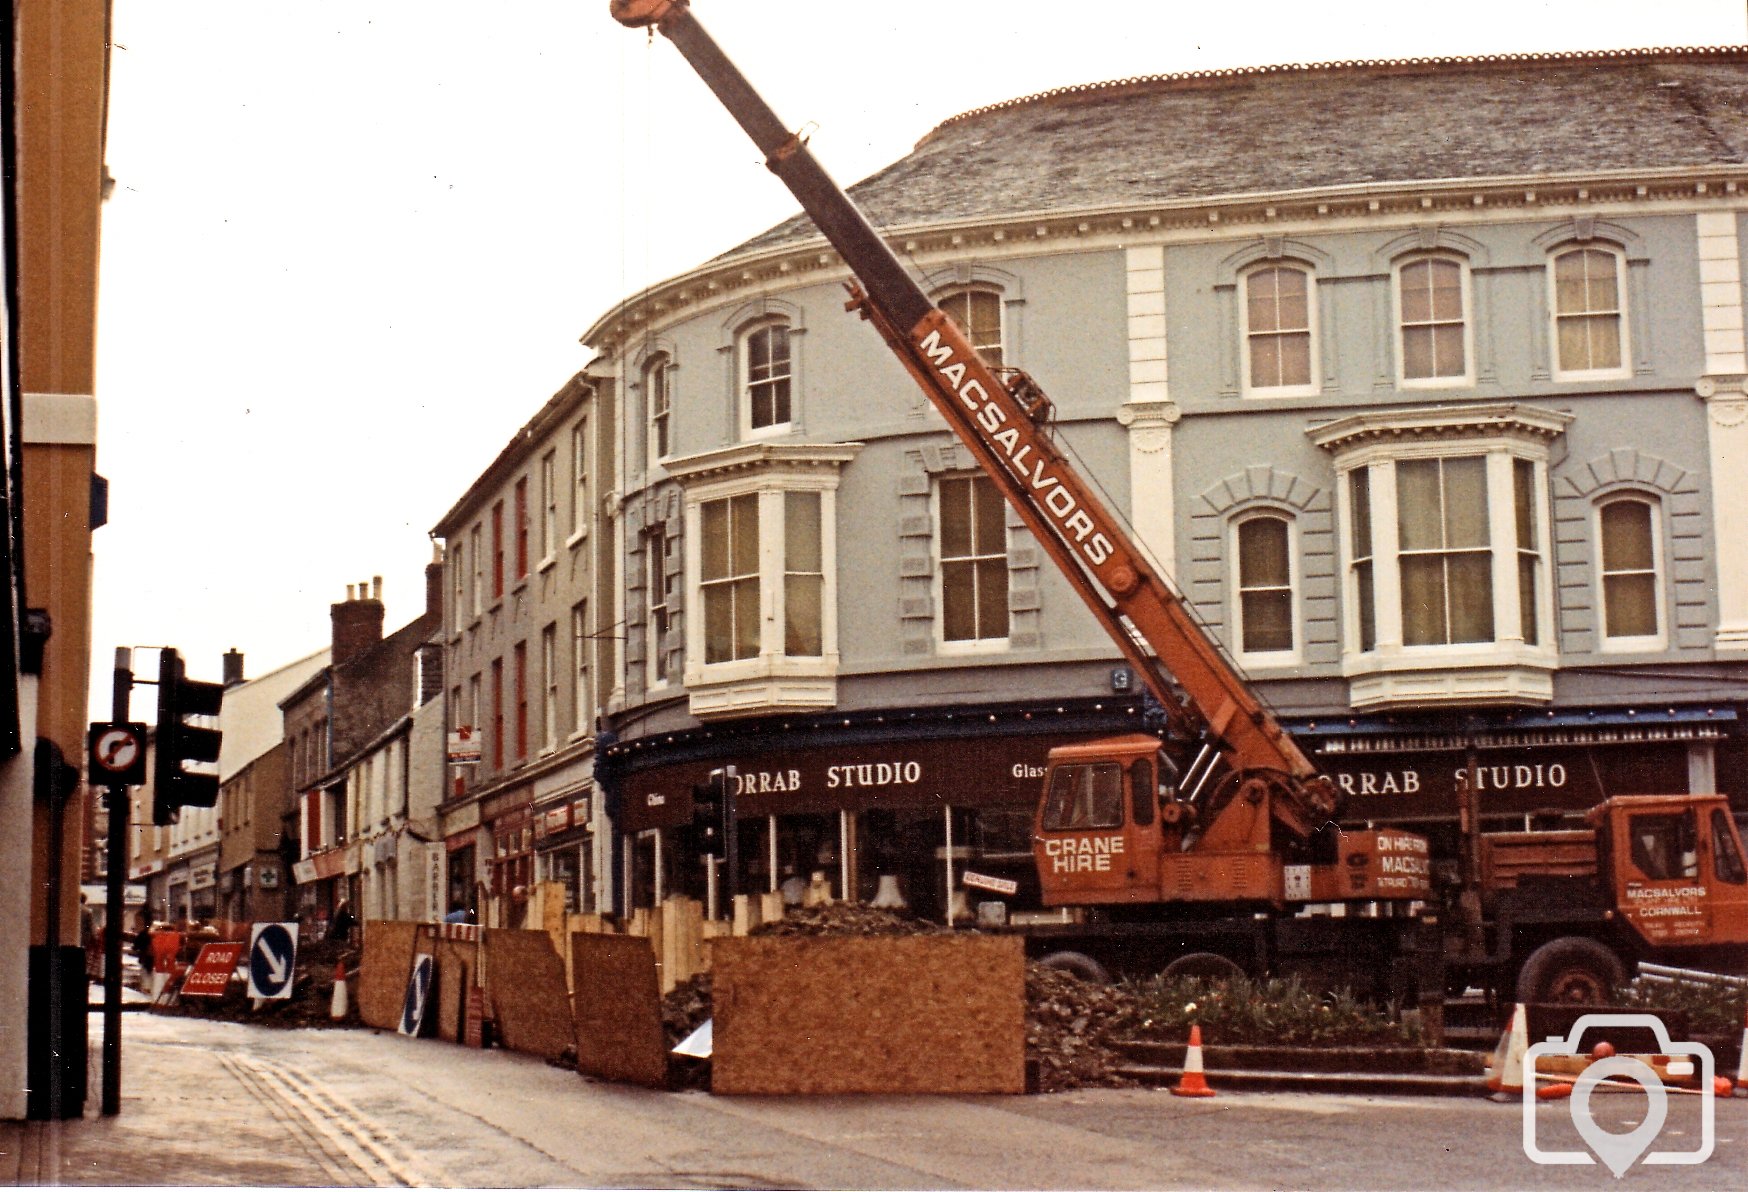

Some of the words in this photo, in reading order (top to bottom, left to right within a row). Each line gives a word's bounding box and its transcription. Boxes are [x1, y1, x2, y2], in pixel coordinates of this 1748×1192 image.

[920, 330, 1114, 565] MACSALVORS
[827, 761, 921, 788] STUDIO
[1045, 836, 1124, 856] CRANE
[1377, 836, 1392, 850] ON
[1053, 853, 1111, 873] HIRE
[1627, 886, 1706, 898] MACSALVORS
[1640, 905, 1702, 917] CORNWALL
[206, 952, 233, 964] ROAD
[190, 972, 229, 984] CLOSED
